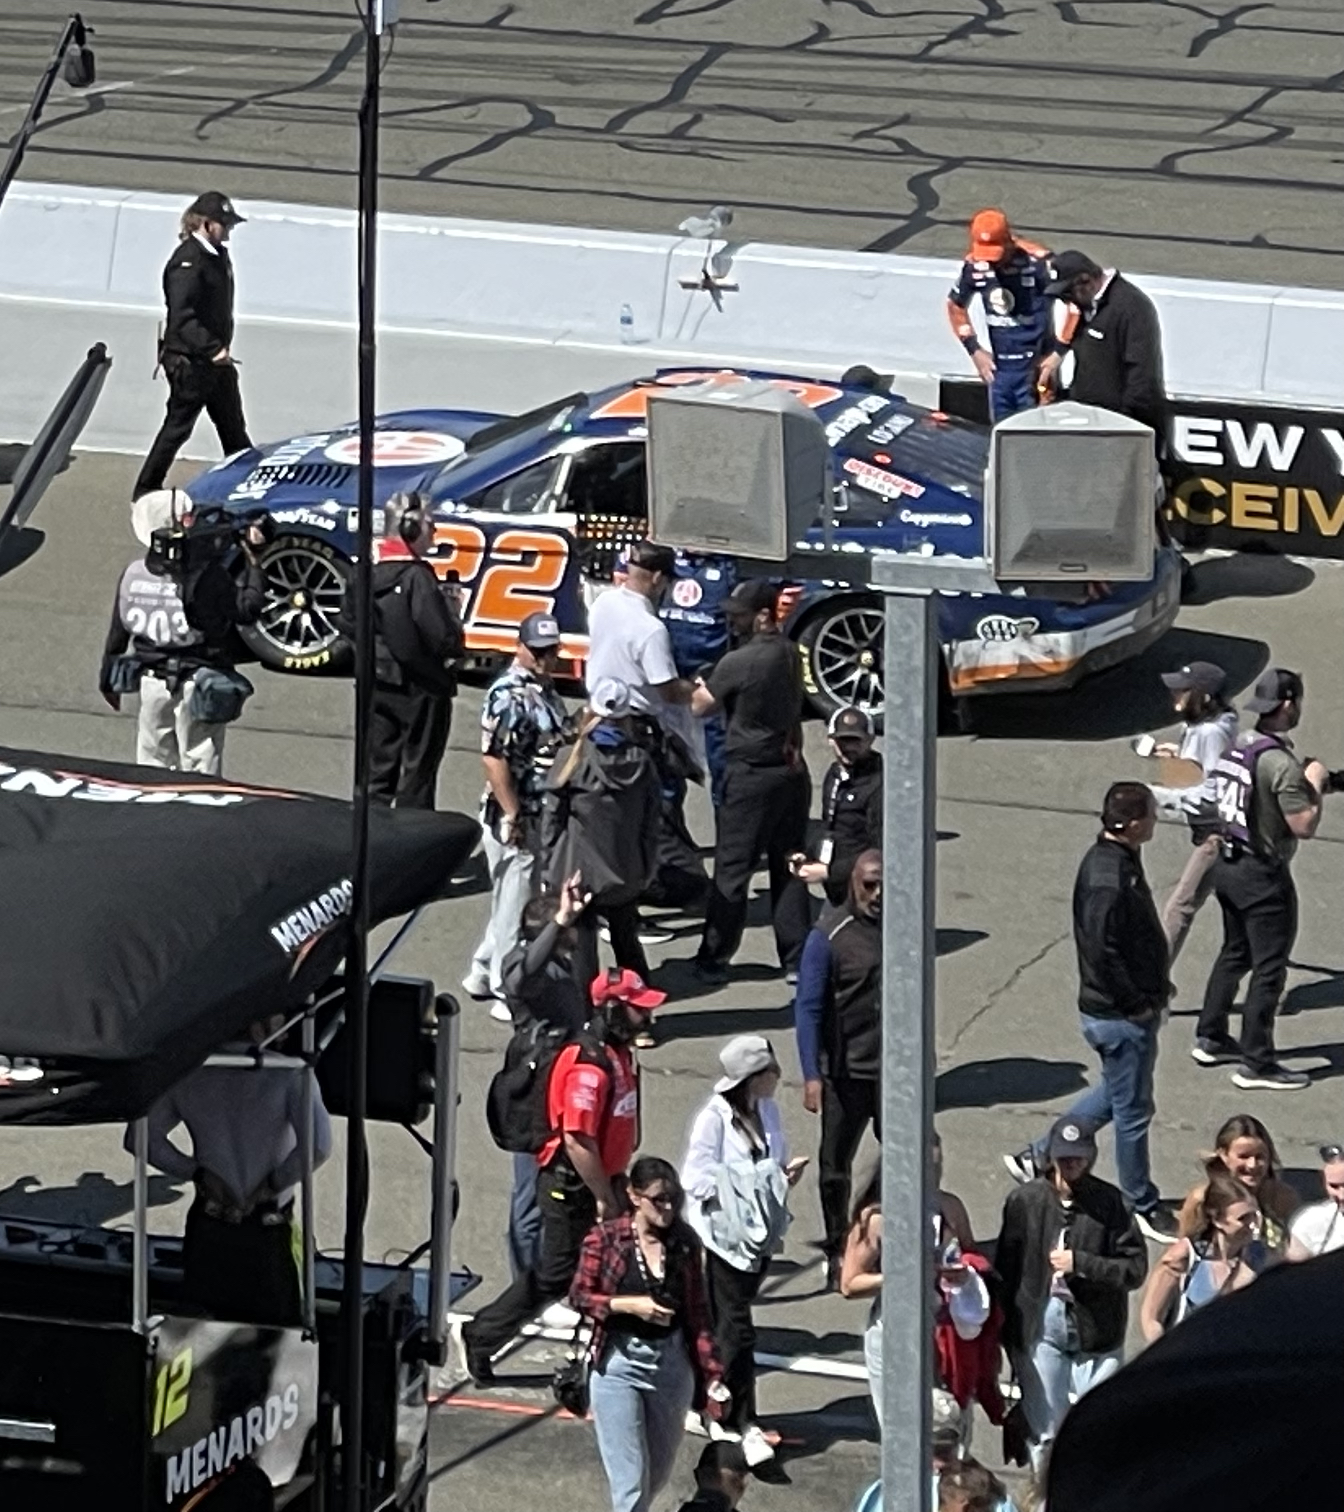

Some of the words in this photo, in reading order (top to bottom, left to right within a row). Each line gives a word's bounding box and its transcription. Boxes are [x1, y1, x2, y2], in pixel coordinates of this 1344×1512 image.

[1173, 415, 1306, 472] EW
[269, 877, 355, 956] MENARDS
[151, 1347, 196, 1439] 12
[164, 1381, 301, 1506] MENARDS
